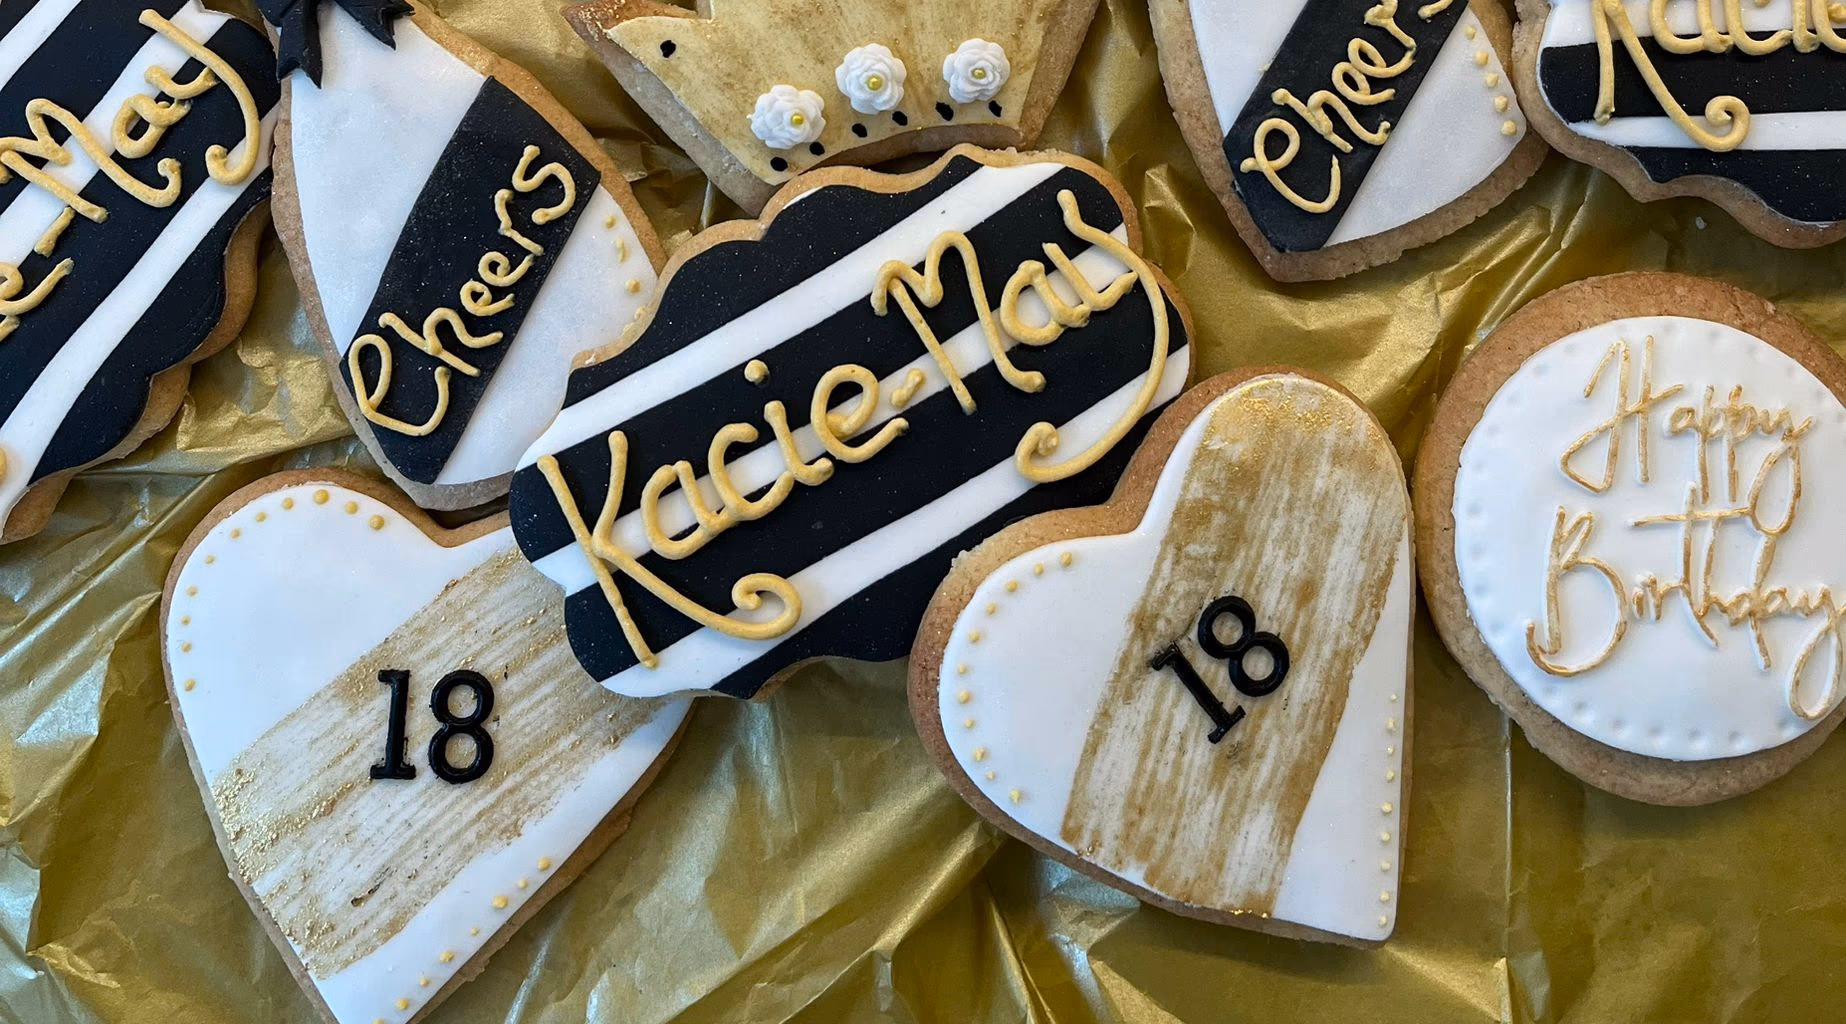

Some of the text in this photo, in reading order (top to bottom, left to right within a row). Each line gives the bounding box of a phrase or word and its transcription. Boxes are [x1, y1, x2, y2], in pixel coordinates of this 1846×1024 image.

[348, 144, 576, 436] Cheers
[537, 189, 1169, 668] Kacie-May
[1559, 334, 1816, 535] Happy
[370, 669, 495, 784] 18
[1151, 595, 1290, 744] 18
